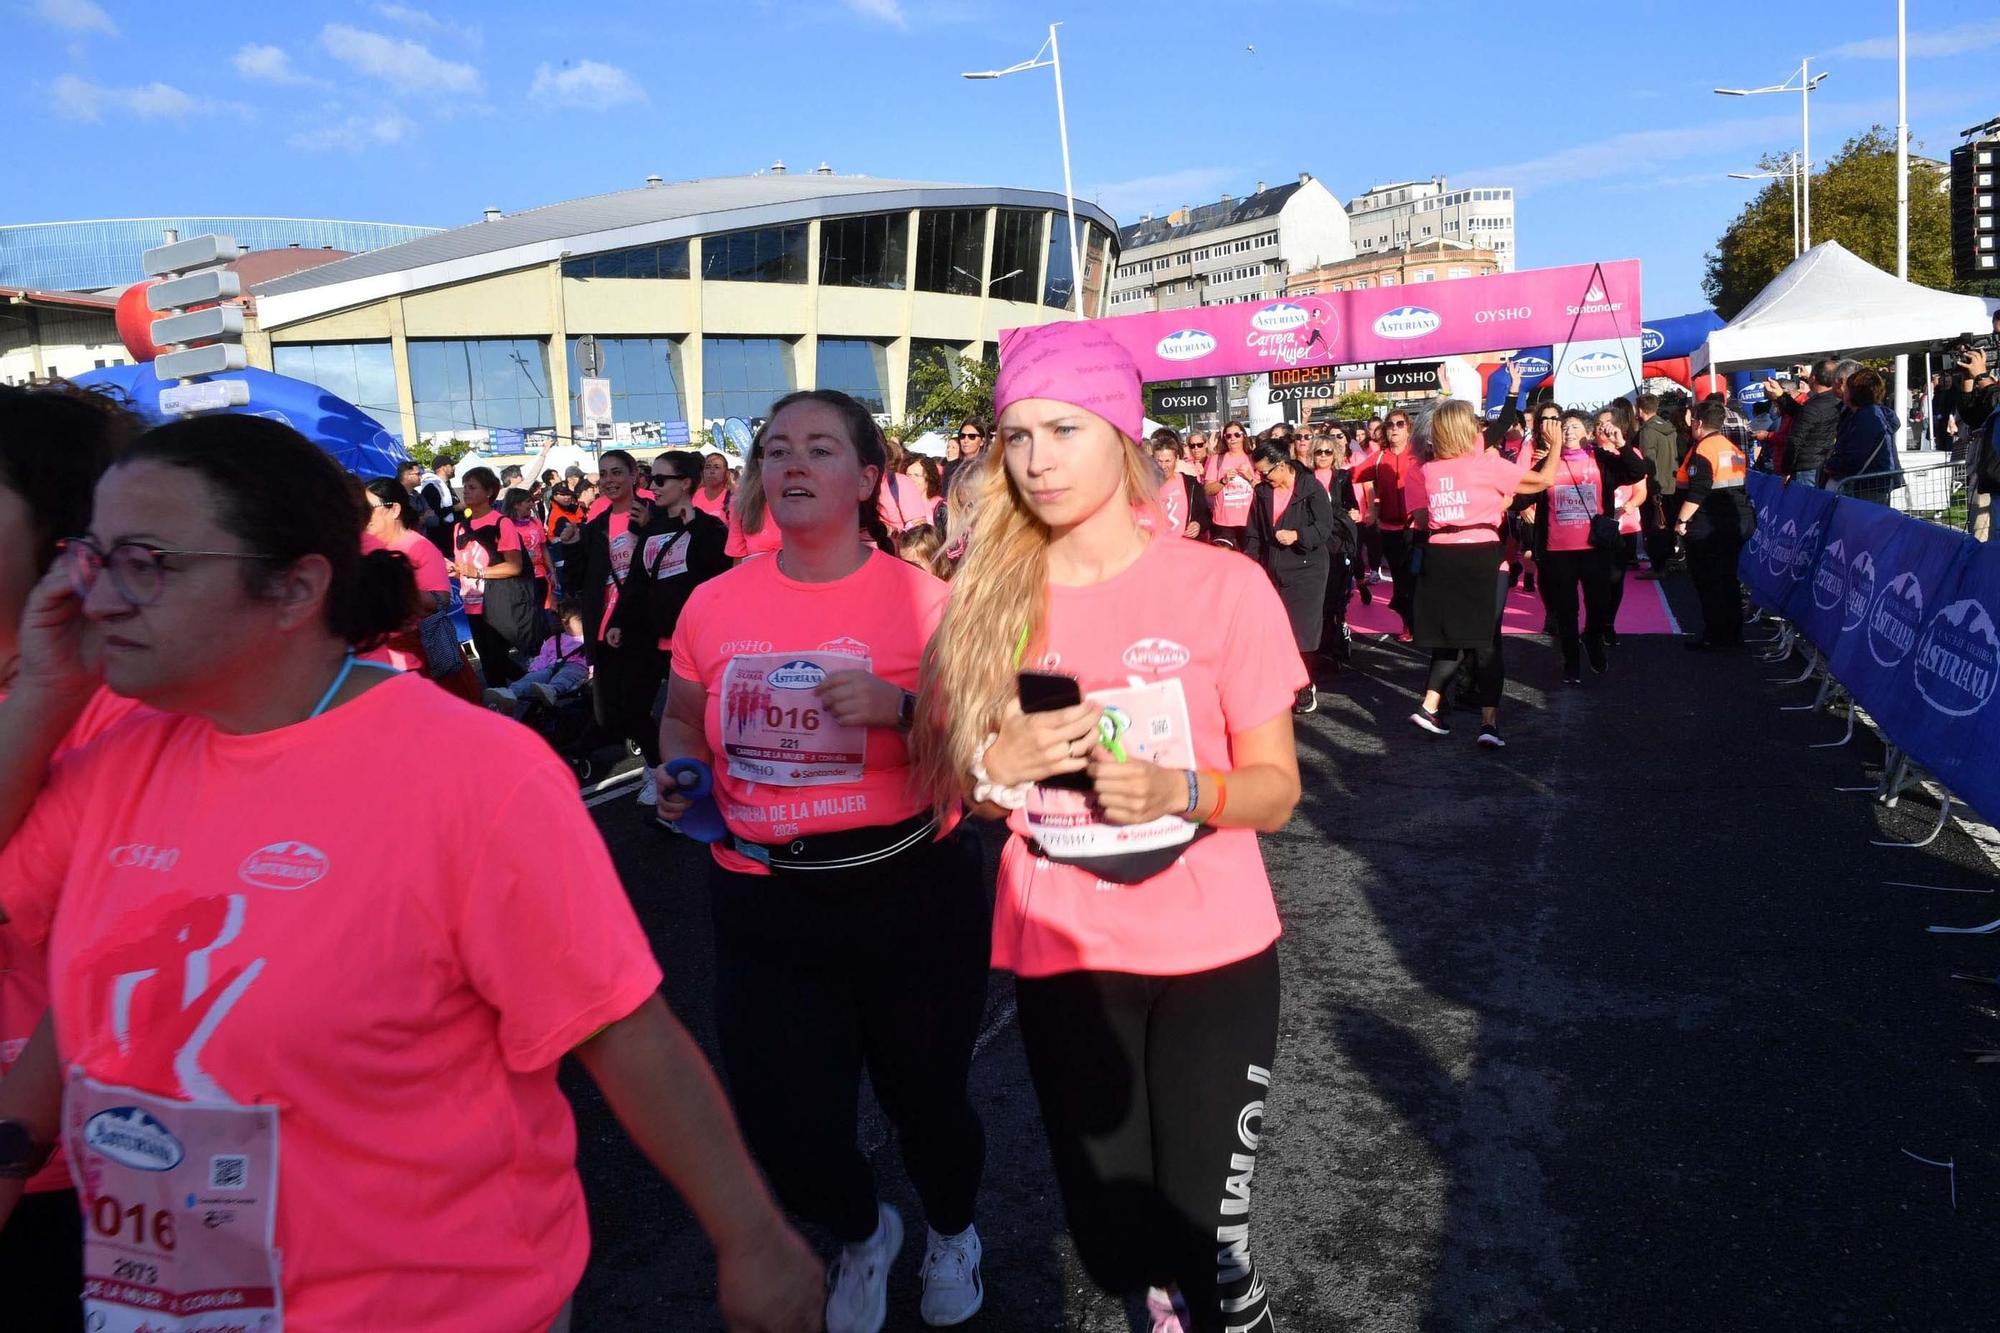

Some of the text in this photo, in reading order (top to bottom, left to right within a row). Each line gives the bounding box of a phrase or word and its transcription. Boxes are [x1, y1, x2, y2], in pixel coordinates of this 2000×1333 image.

[1474, 306, 1532, 323] OYSHO
[1566, 300, 1622, 316] Santander
[1255, 315, 1306, 327] ASTURIANA
[1378, 318, 1436, 332] ASTURIANA
[1246, 332, 1295, 348] Carrera
[1160, 342, 1213, 355] ASTURIANA
[1275, 341, 1313, 366] Mujer
[1572, 362, 1623, 375] ASTURIANA
[1385, 370, 1436, 385] OYSHO
[1161, 395, 1208, 408] OYSHO
[1271, 386, 1331, 402] OYSHO
[1439, 477, 1454, 491] TU
[1430, 491, 1470, 508] DORSAL
[1434, 505, 1465, 522] SUMA
[720, 640, 773, 655] OYSHO
[1918, 626, 1990, 700] ASTURIANA
[772, 673, 822, 683] ASTURIANA
[766, 705, 820, 731] 016
[780, 738, 799, 750] 221
[763, 750, 772, 758] DE
[773, 751, 781, 759] LA
[783, 752, 805, 761] MUJER
[802, 769, 847, 778] Santander
[770, 804, 787, 821] DE
[791, 803, 809, 820] LA
[813, 795, 866, 817] MUJER
[93, 1195, 176, 1252] 016
